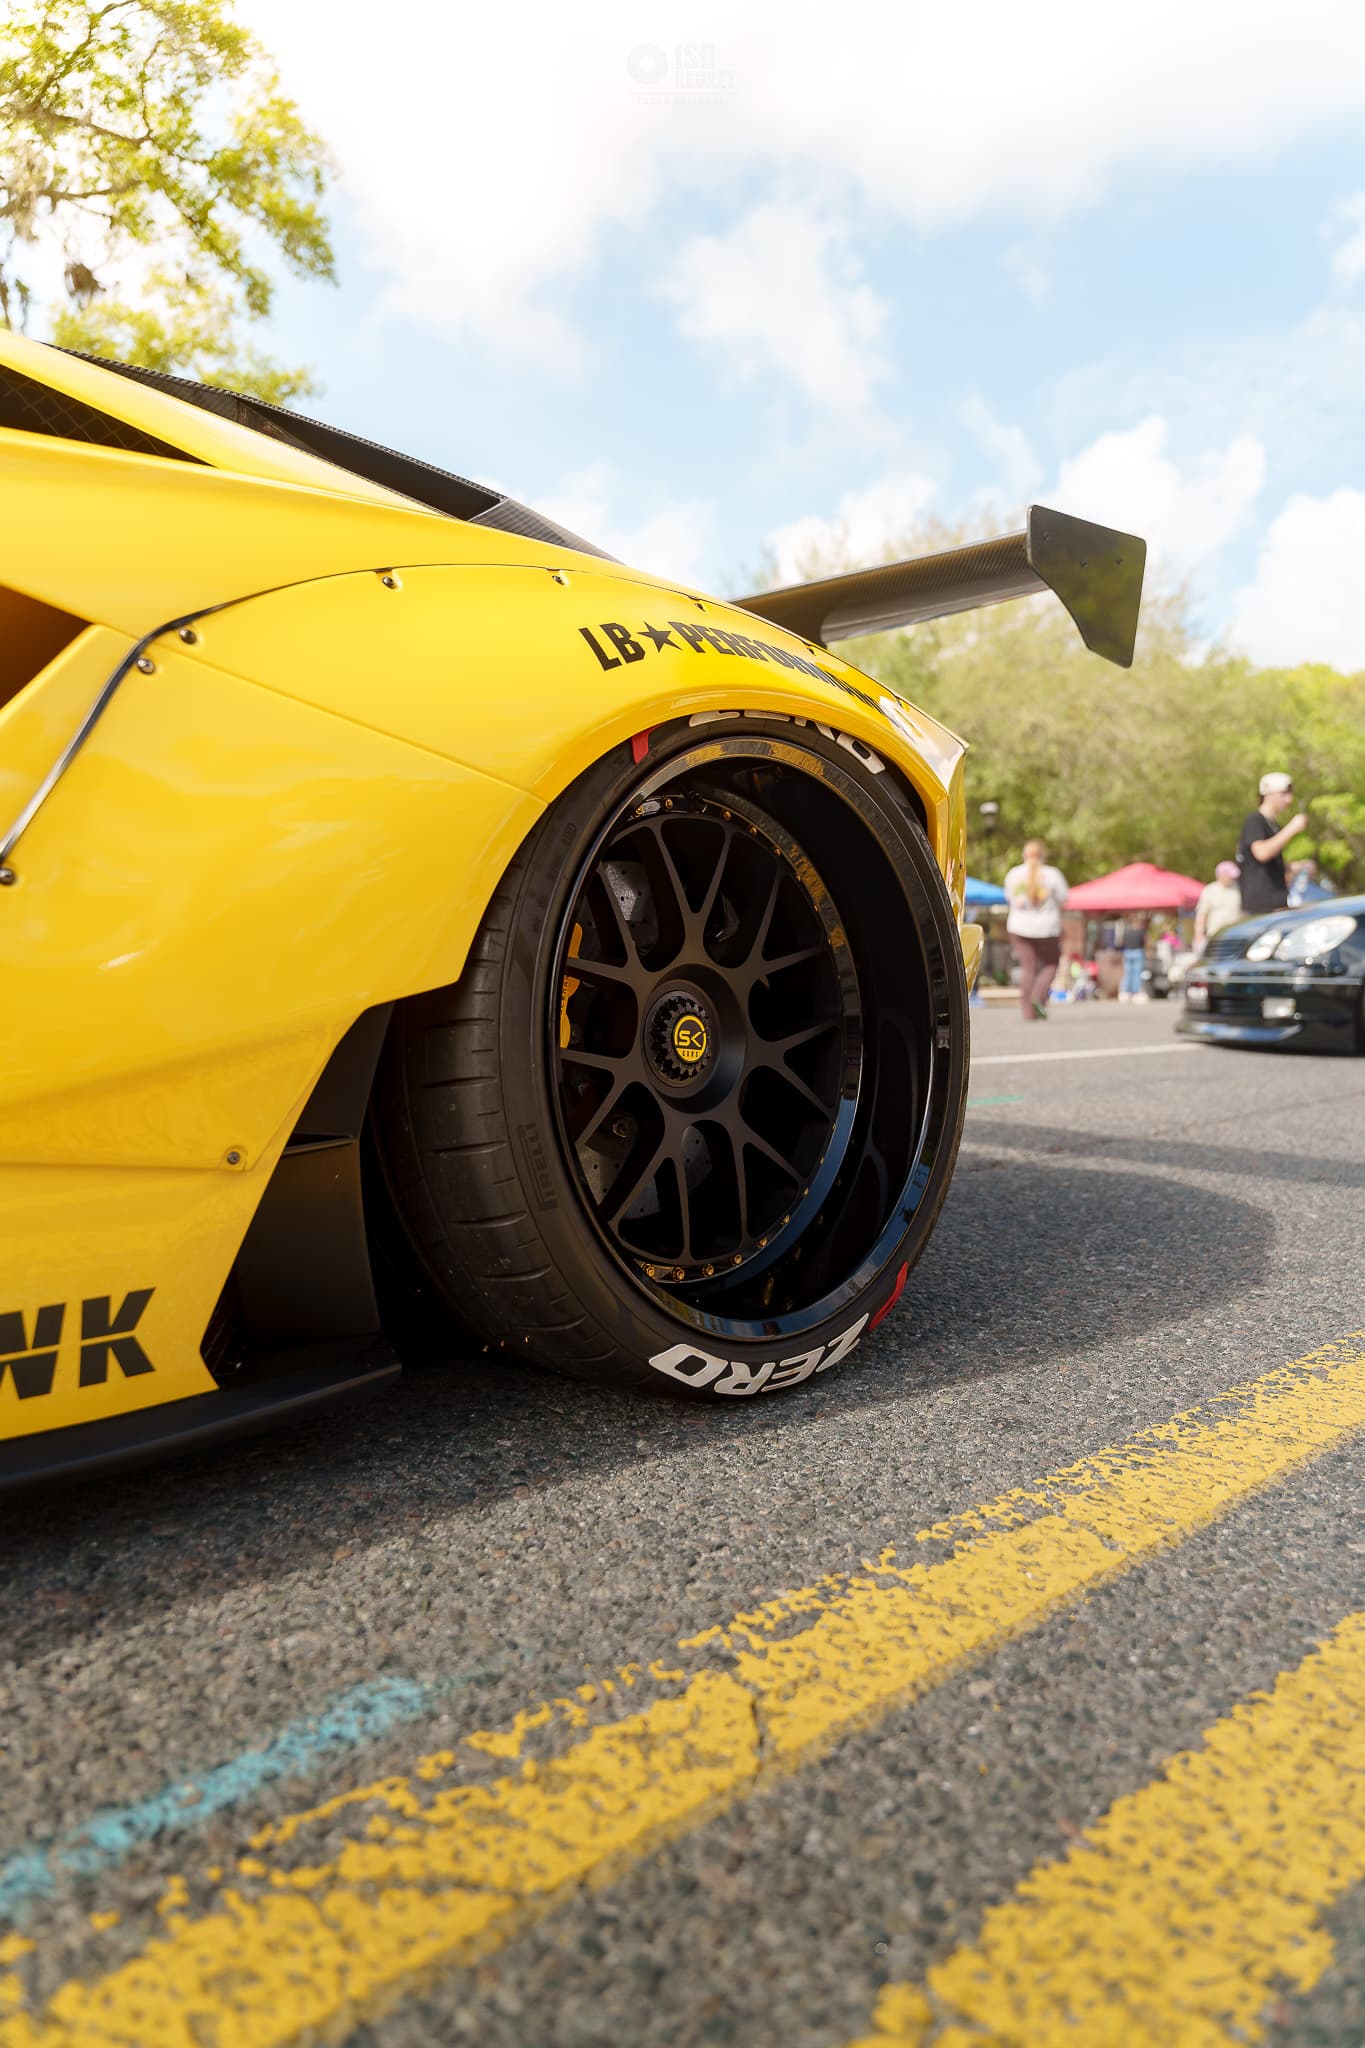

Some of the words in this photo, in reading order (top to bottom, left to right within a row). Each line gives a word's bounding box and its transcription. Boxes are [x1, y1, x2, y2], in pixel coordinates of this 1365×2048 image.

[578, 622, 646, 671] LB
[667, 621, 908, 735] PERFORM
[678, 1029, 703, 1048] SK
[648, 1312, 870, 1396] ZERO
